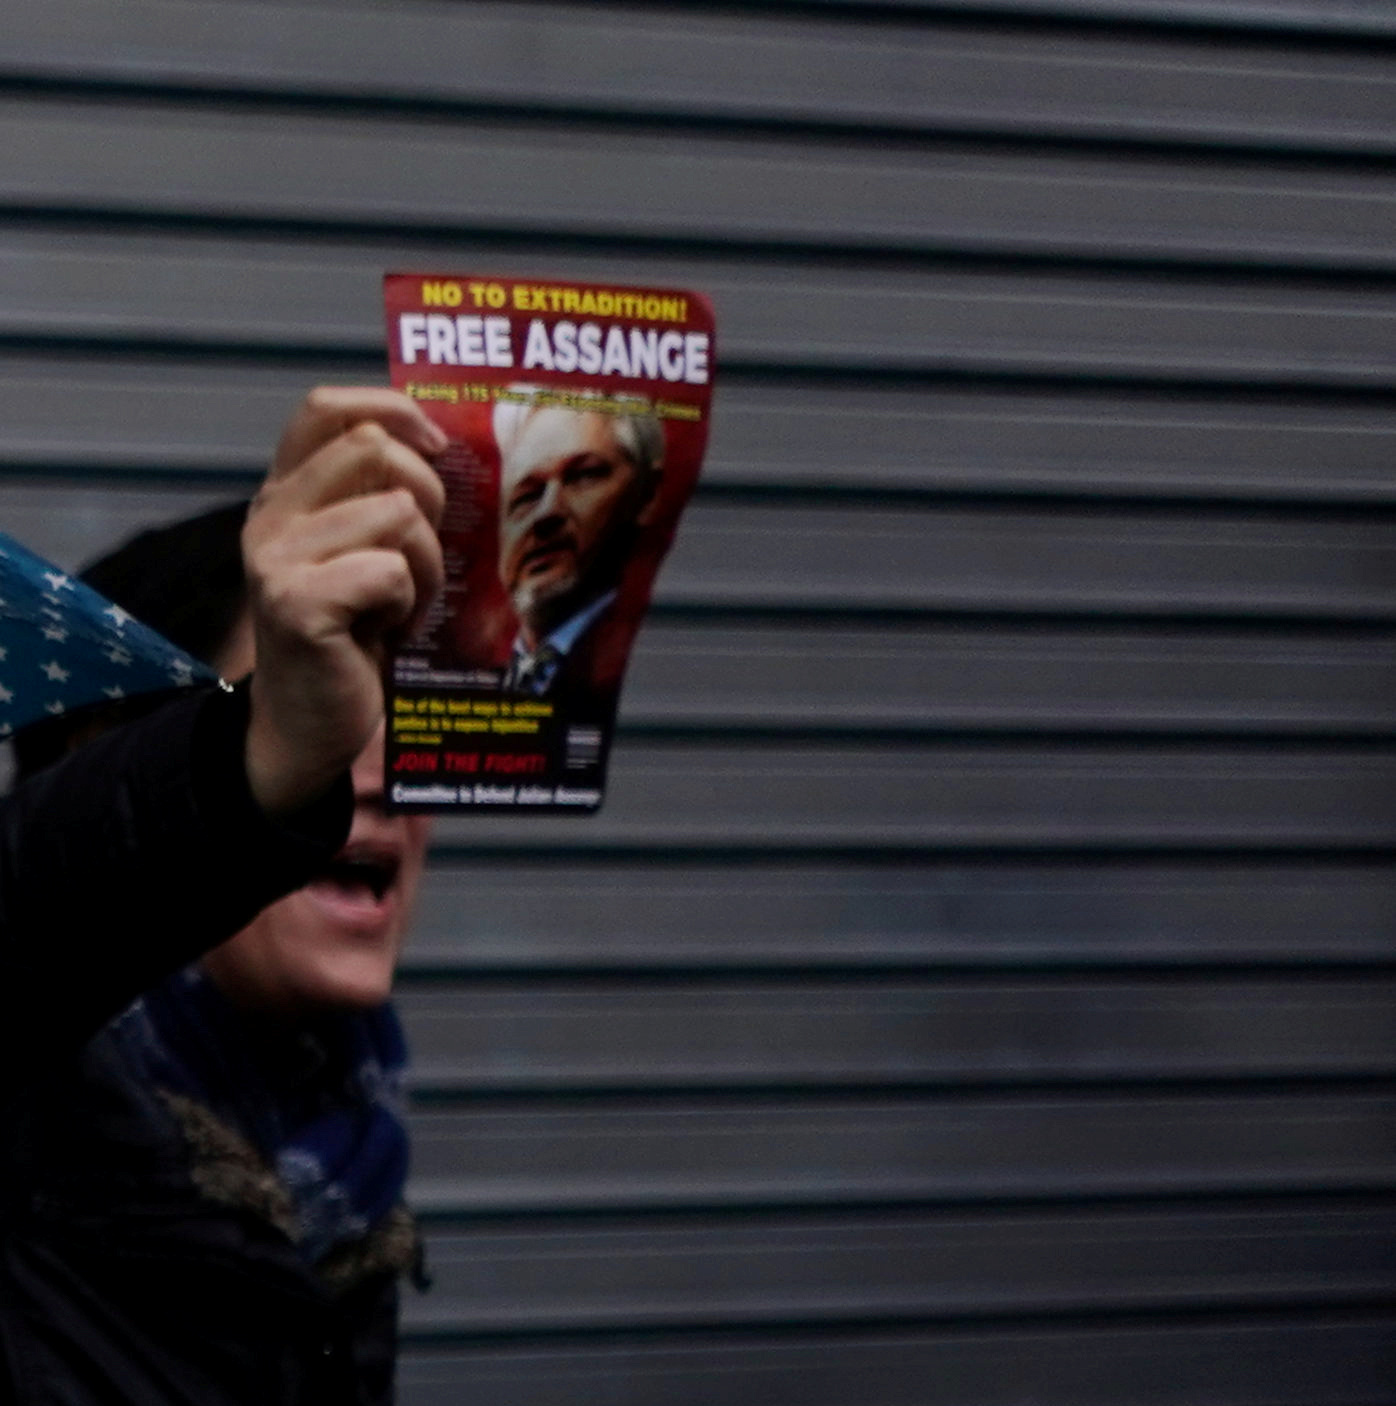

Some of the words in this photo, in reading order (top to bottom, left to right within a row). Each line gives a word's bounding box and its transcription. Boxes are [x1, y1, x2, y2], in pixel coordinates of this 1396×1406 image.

[422, 280, 462, 307] NO
[470, 282, 506, 308] TO
[513, 285, 688, 322] EXTRADITION!
[399, 313, 513, 368] FREE
[523, 319, 708, 384] ASSANGE
[392, 752, 439, 772] JOIN
[443, 752, 480, 773] THE
[483, 753, 548, 774] FIGHT!
